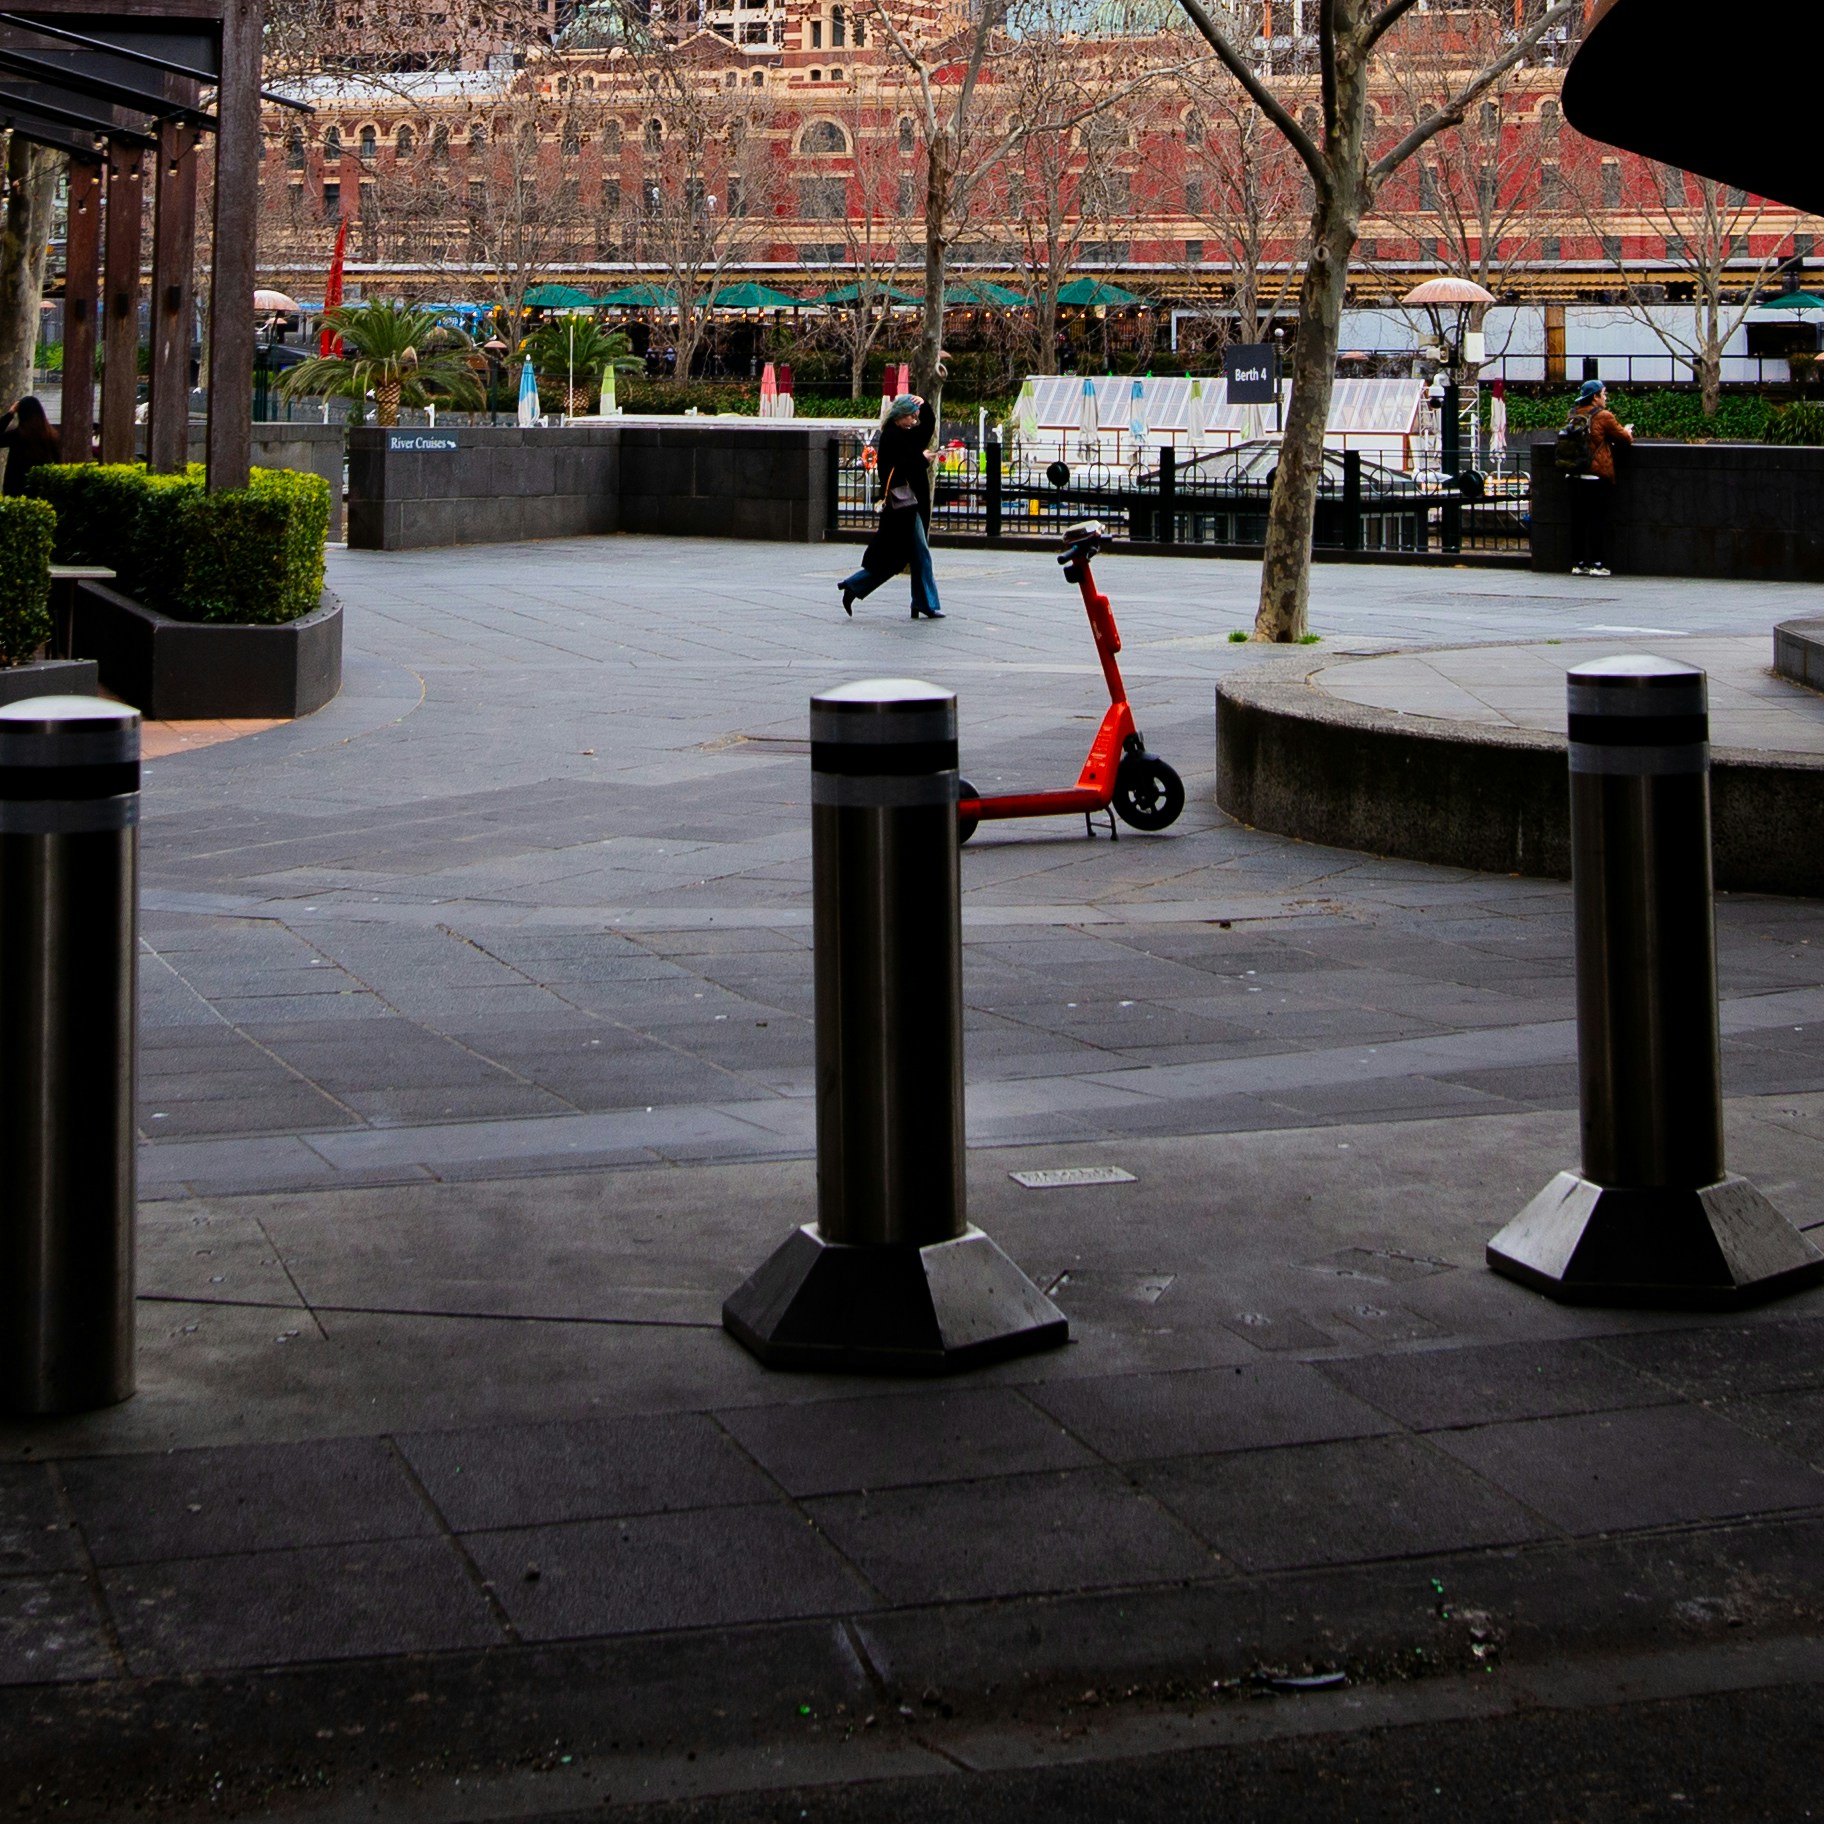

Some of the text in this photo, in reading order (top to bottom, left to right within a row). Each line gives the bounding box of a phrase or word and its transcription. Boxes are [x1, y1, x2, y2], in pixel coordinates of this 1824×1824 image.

[1235, 366, 1267, 382] Berth 4
[390, 436, 447, 449] River Cruises
